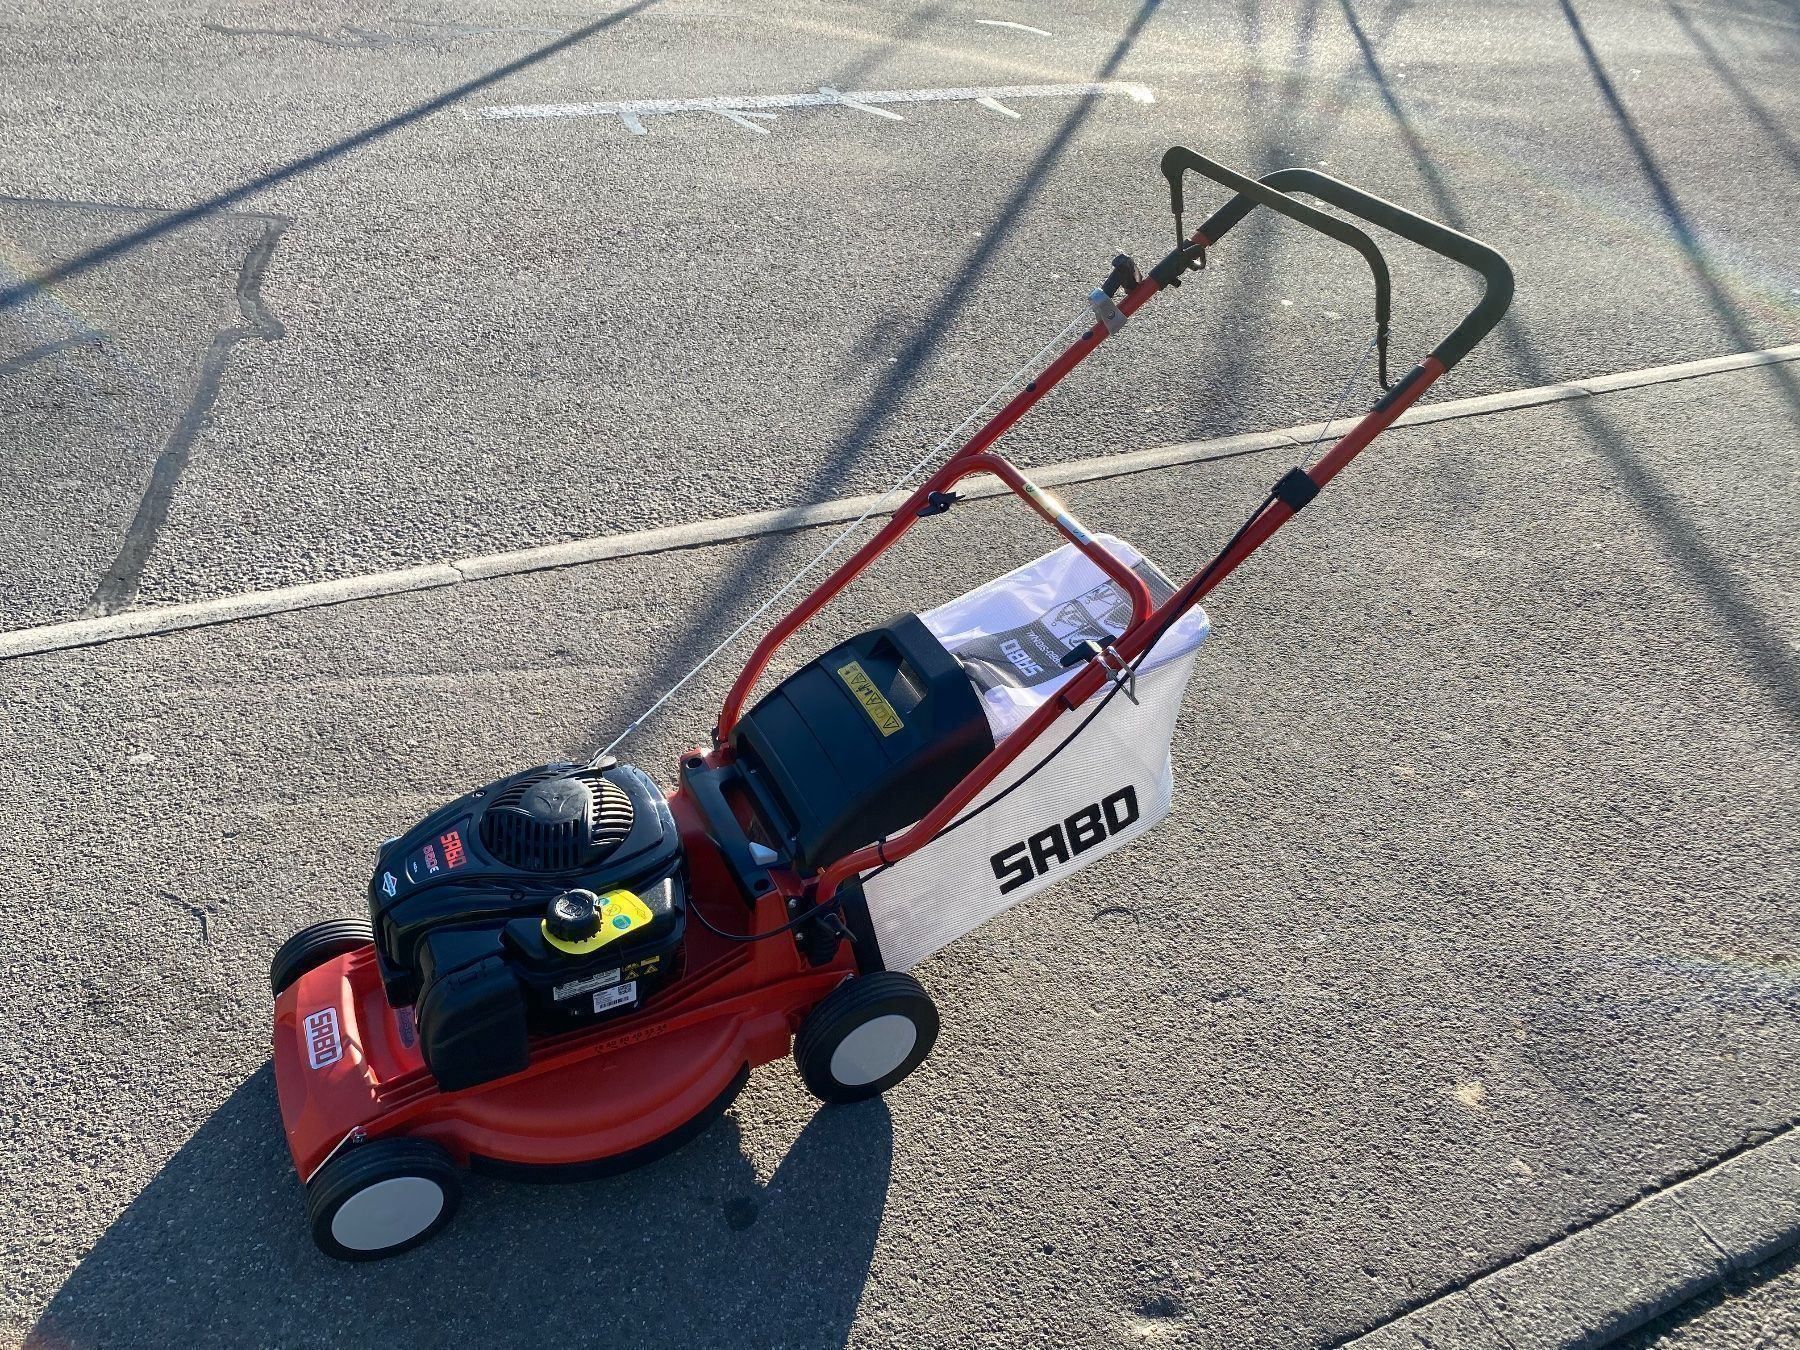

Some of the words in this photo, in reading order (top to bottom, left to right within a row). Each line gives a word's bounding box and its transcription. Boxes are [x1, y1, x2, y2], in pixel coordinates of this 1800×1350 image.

[1000, 639, 1044, 677] SABO
[440, 831, 467, 869] SABO
[990, 784, 1140, 895] SABO
[310, 1012, 338, 1065] SABO
